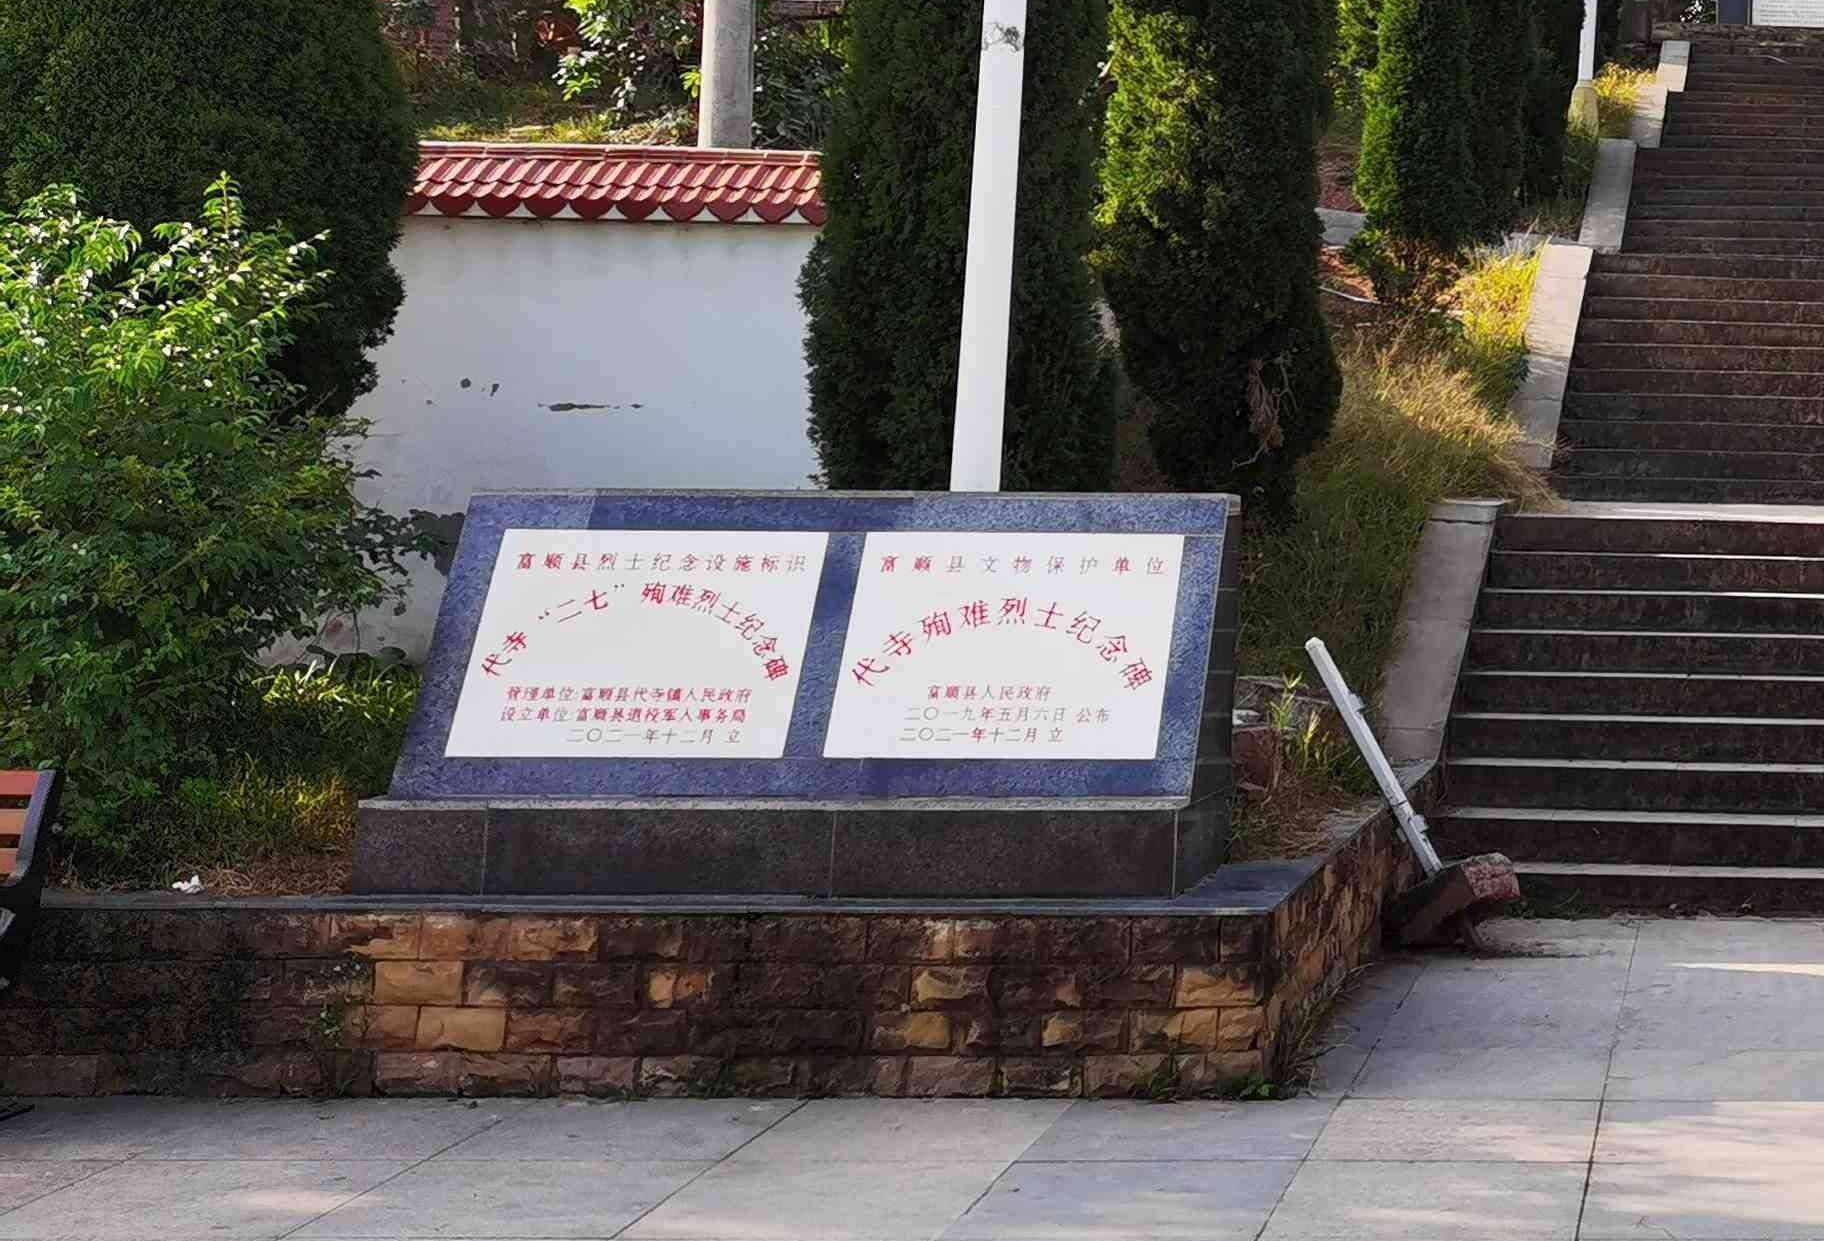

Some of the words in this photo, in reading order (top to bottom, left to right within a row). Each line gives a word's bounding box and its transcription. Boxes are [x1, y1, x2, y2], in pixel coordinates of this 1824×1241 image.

[515, 552, 807, 573] 富顺县烈士纪念设施标识
[879, 555, 1170, 576] 富顺县文物保护单位
[851, 596, 1153, 691] 代寺殉难烈士纪念碑
[927, 685, 1053, 702] 富顺县人民政府
